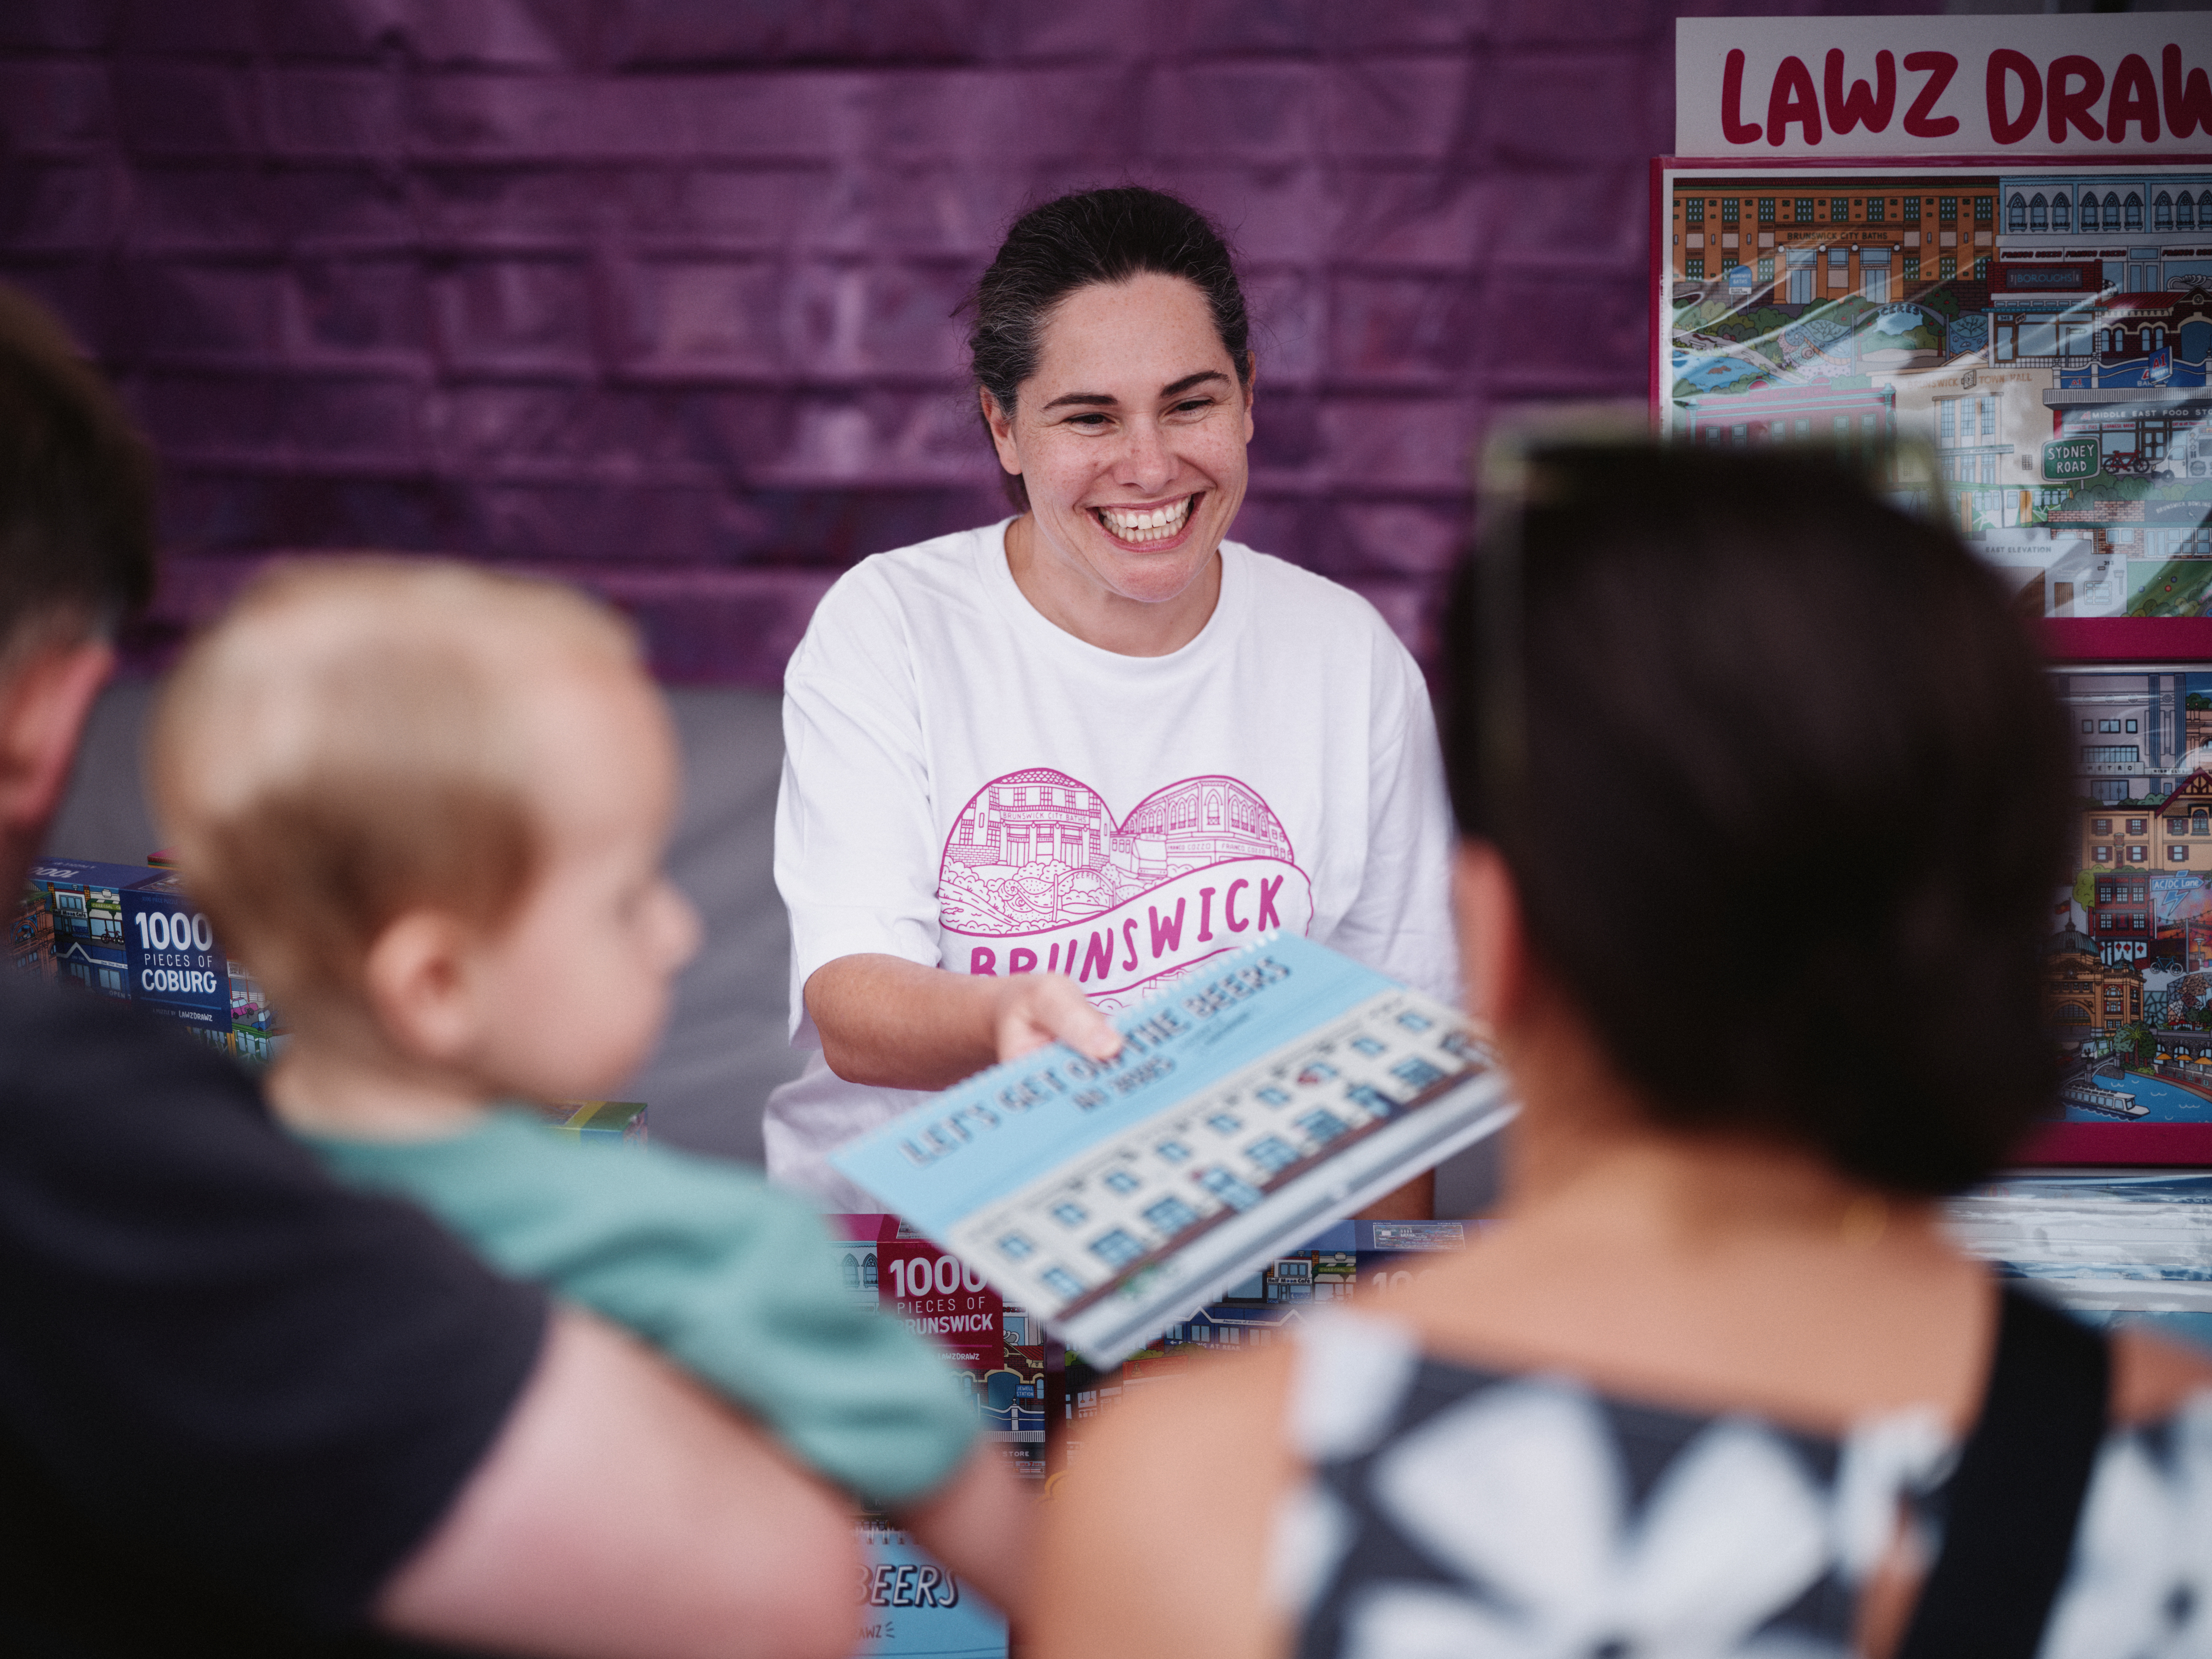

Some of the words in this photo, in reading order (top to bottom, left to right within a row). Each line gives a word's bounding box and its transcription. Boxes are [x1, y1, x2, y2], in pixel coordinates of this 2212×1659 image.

[1721, 47, 1960, 146] LAWZ
[1986, 43, 2212, 145] DRAW
[2017, 274, 2072, 283] BOROUGHS
[1881, 305, 1920, 315] CERES
[2152, 353, 2167, 370] A1
[1979, 375, 2005, 384] TOWN
[2047, 444, 2095, 460] SYDNEY
[2057, 459, 2087, 473] ROAD
[2156, 501, 2186, 514] BRUNSWICK
[1065, 814, 1087, 823] BATHS
[1221, 843, 1245, 852] FRANCO
[1247, 846, 1266, 855] COZZO
[1075, 872, 1099, 883] CERES
[2154, 878, 2179, 889] AC/DC
[134, 912, 213, 951] 1000
[144, 954, 190, 967] PIECES
[198, 955, 212, 967] OF
[142, 969, 217, 993] COBURG
[1182, 956, 1290, 1019] BEERS
[109, 990, 125, 999] OPEN
[179, 1010, 213, 1022] LAWZDRAWZ
[888, 1255, 988, 1297] 1000
[897, 1298, 956, 1315] PIECES
[967, 1296, 985, 1310] OF
